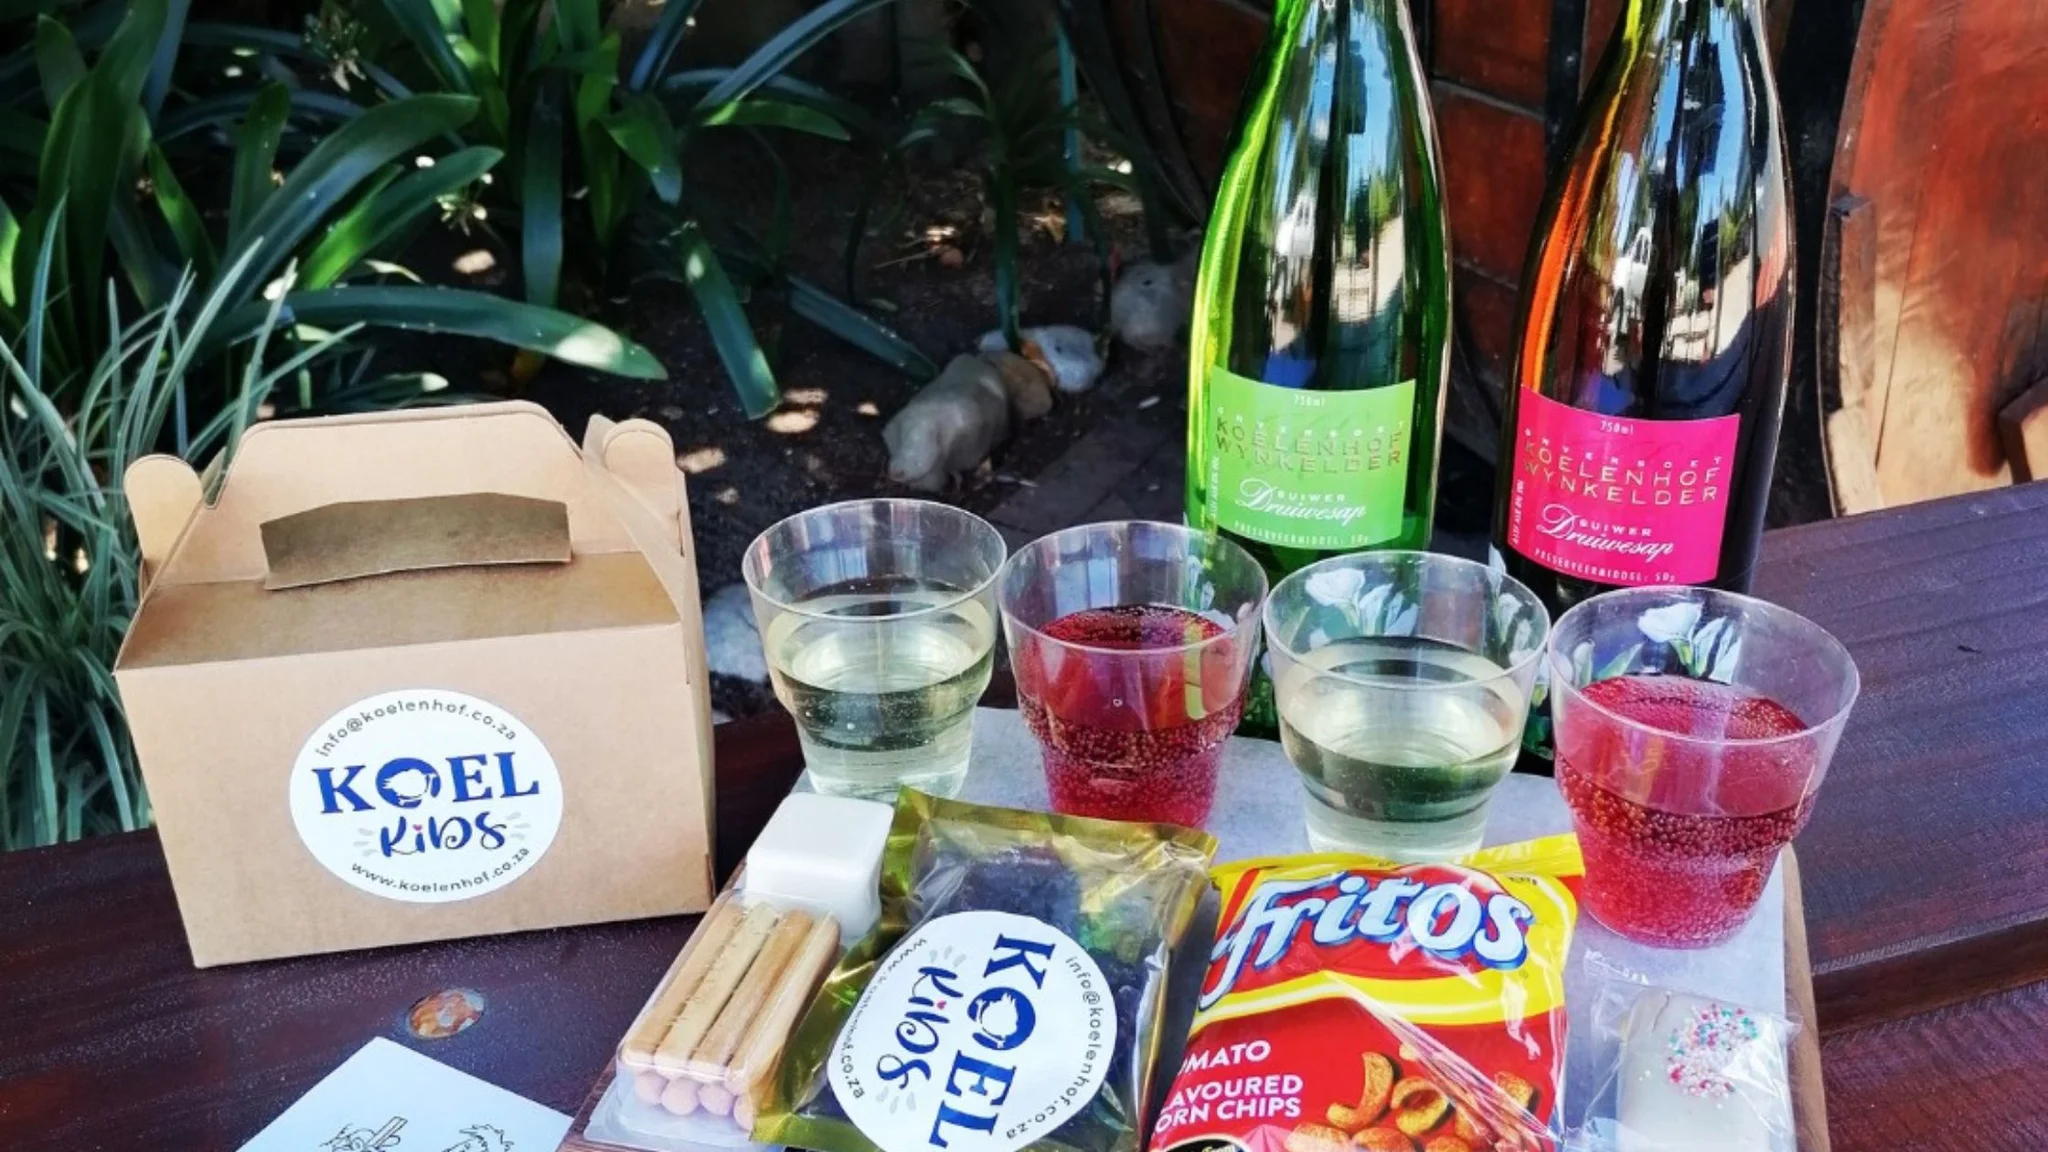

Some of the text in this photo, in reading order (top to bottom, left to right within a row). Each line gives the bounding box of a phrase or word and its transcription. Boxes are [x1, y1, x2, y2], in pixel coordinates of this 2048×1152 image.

[1216, 416, 1403, 456] KOELENHOF
[1600, 421, 1634, 435] 750ml
[1215, 434, 1401, 474] WYNKELDER
[1524, 441, 1721, 486] KOELENHOF
[1235, 478, 1367, 526] Druiwesap
[1523, 461, 1718, 505] WYNKELDER
[1536, 503, 1674, 563] Druiwesap
[315, 698, 517, 757] info@koelenhof.co.za
[311, 751, 540, 814] KOEL
[351, 848, 530, 893] www.koelenhof.co.za
[928, 933, 1056, 1149] KOEL
[1006, 955, 1103, 1140] info@koelenhof.co.za
[1178, 1040, 1272, 1076] MATO
[1154, 1097, 1301, 1133] ORN CHIPS
[1160, 1074, 1304, 1115] AVOURED
